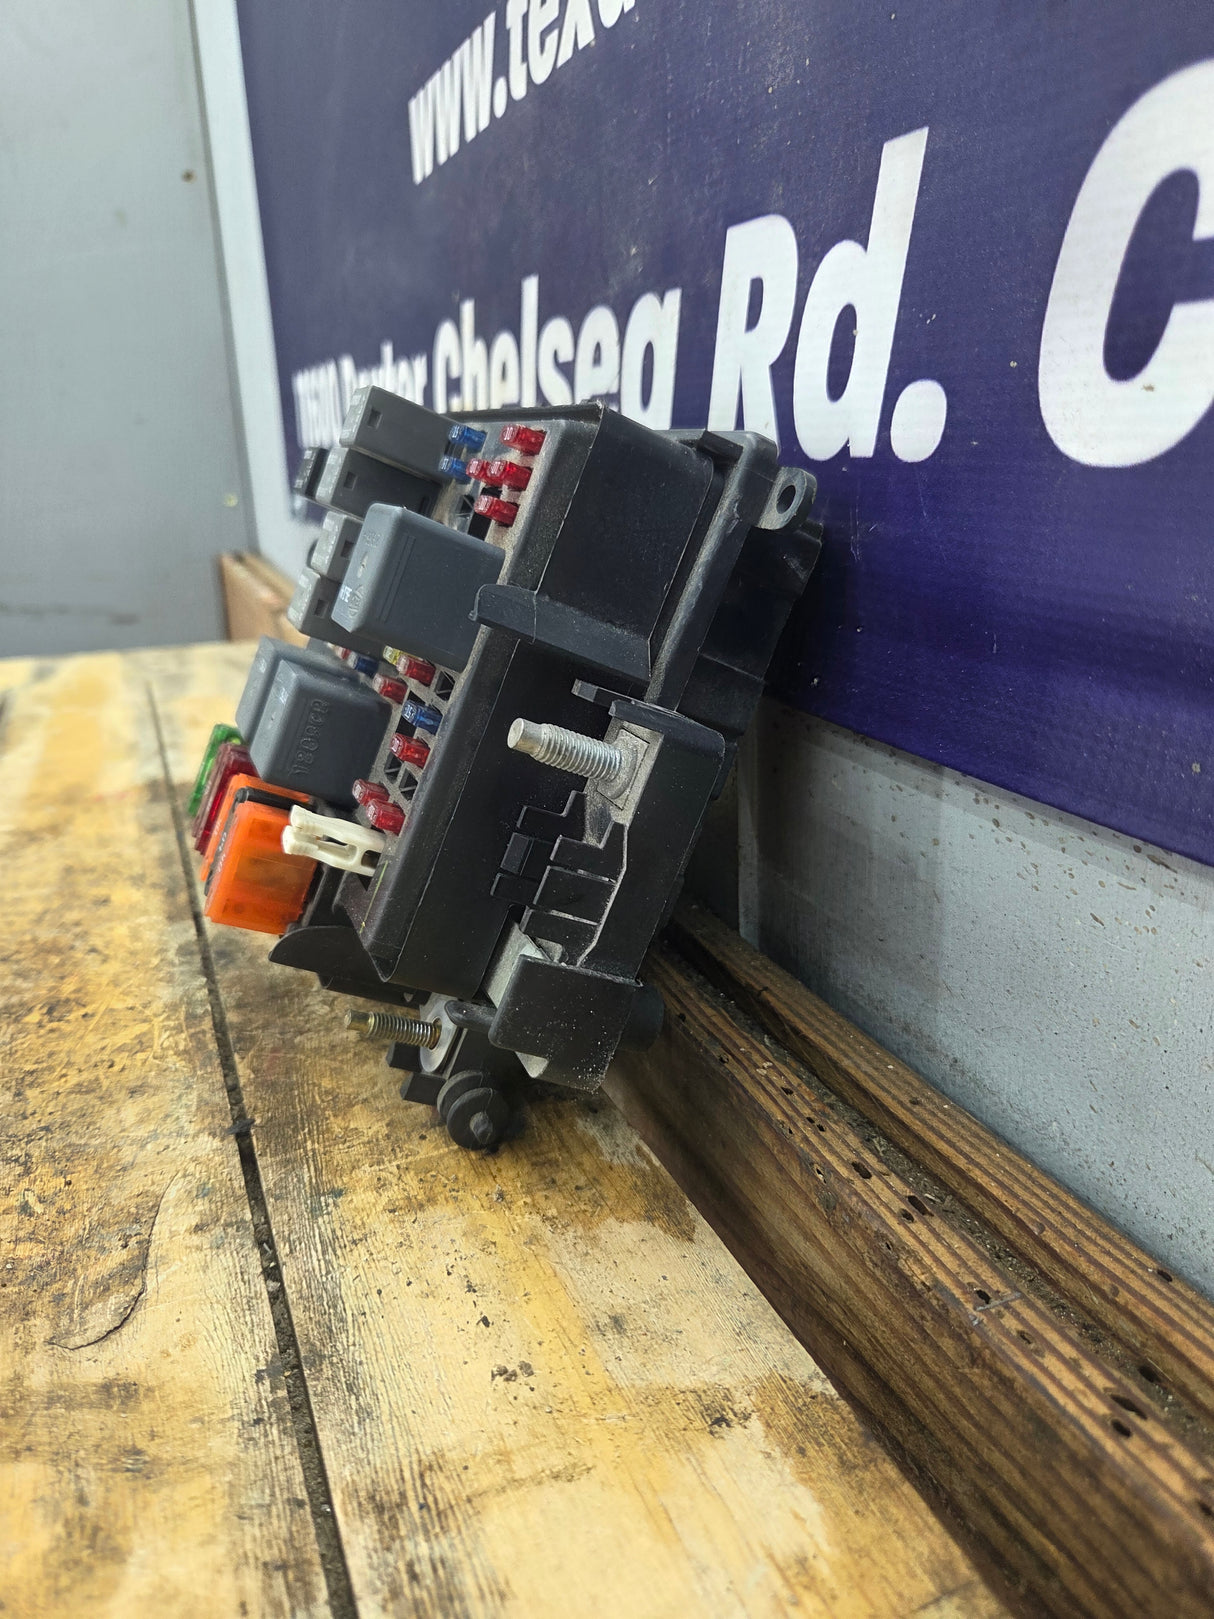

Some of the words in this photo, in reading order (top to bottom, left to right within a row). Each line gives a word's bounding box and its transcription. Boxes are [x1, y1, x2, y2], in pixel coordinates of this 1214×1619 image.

[408, 0, 635, 185] www.tex
[433, 273, 682, 431] Chelsea
[707, 126, 948, 463] Rd.
